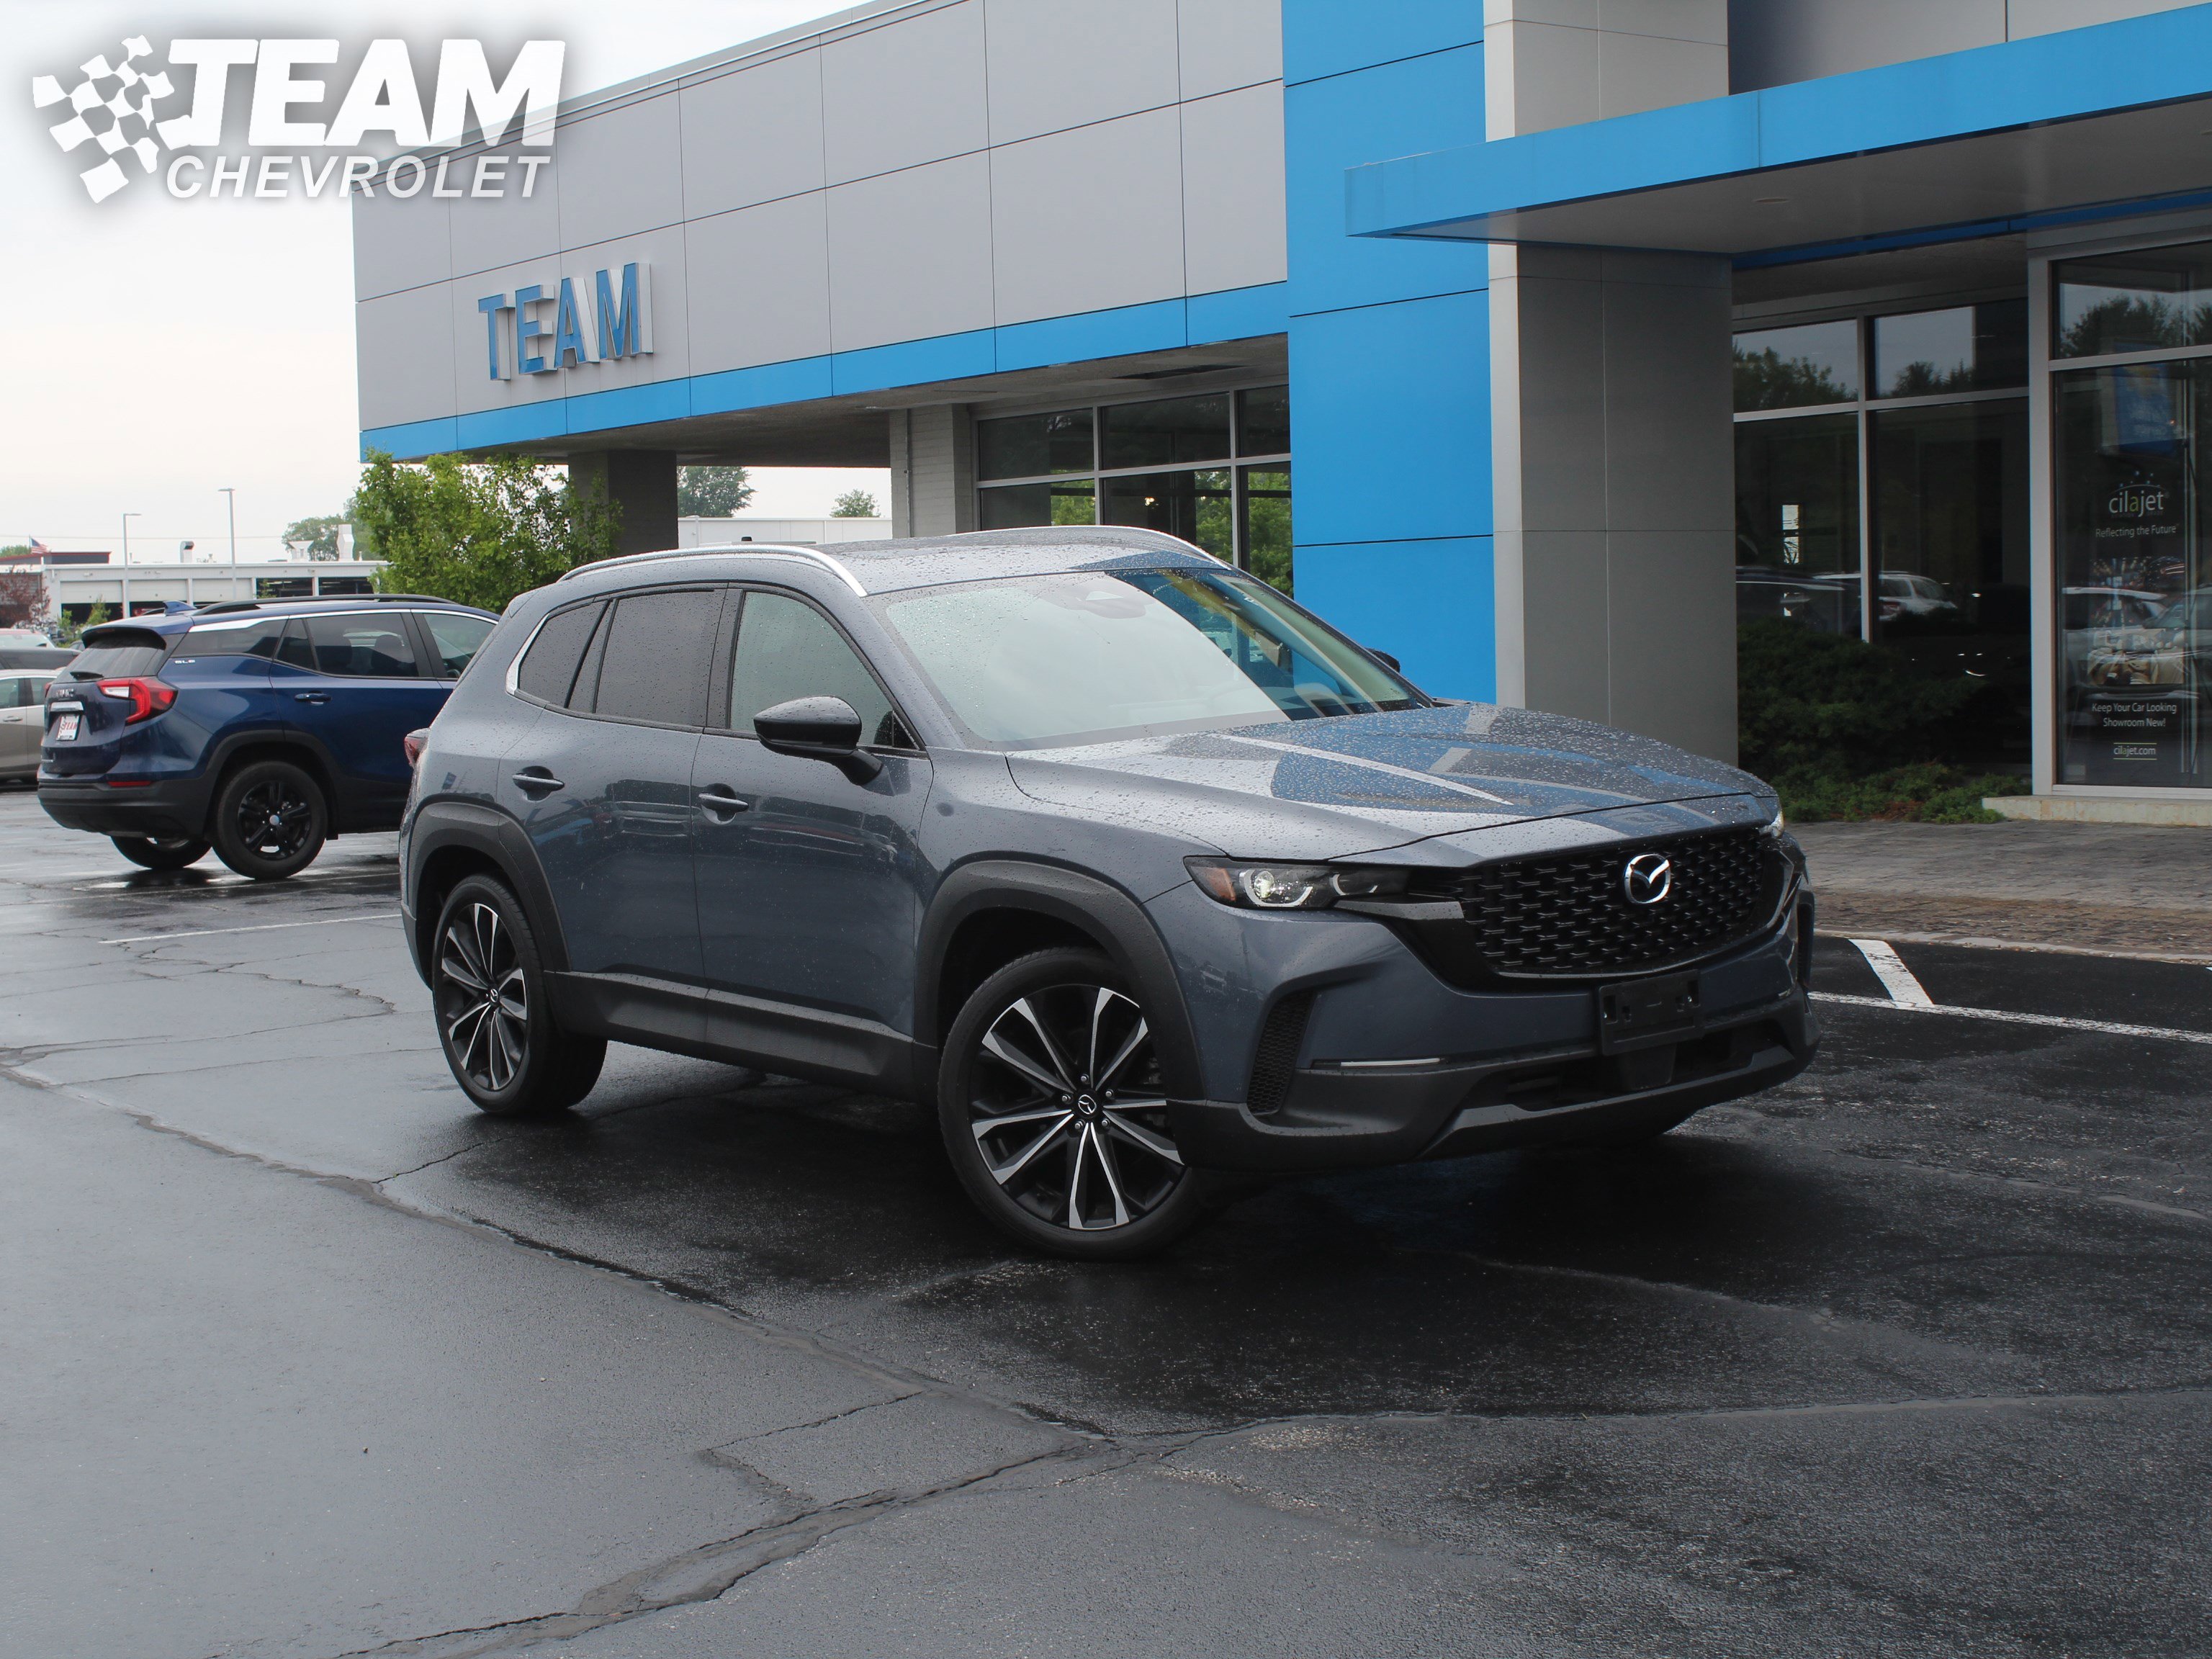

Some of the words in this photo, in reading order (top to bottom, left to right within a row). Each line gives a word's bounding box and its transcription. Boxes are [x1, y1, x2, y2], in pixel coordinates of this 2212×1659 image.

[478, 262, 653, 380] TEAM
[2108, 490, 2164, 517] cilajet
[2095, 527, 2135, 538] Reflecting
[2136, 526, 2149, 535] the
[2151, 525, 2176, 534] Future
[2092, 703, 2112, 714] Keep
[2113, 703, 2131, 712] Your
[2132, 703, 2145, 712] Car
[2146, 703, 2177, 714] Looking
[2103, 717, 2145, 727] Showroom
[2146, 717, 2166, 727] New!
[2113, 746, 2157, 757] cilajet.com
